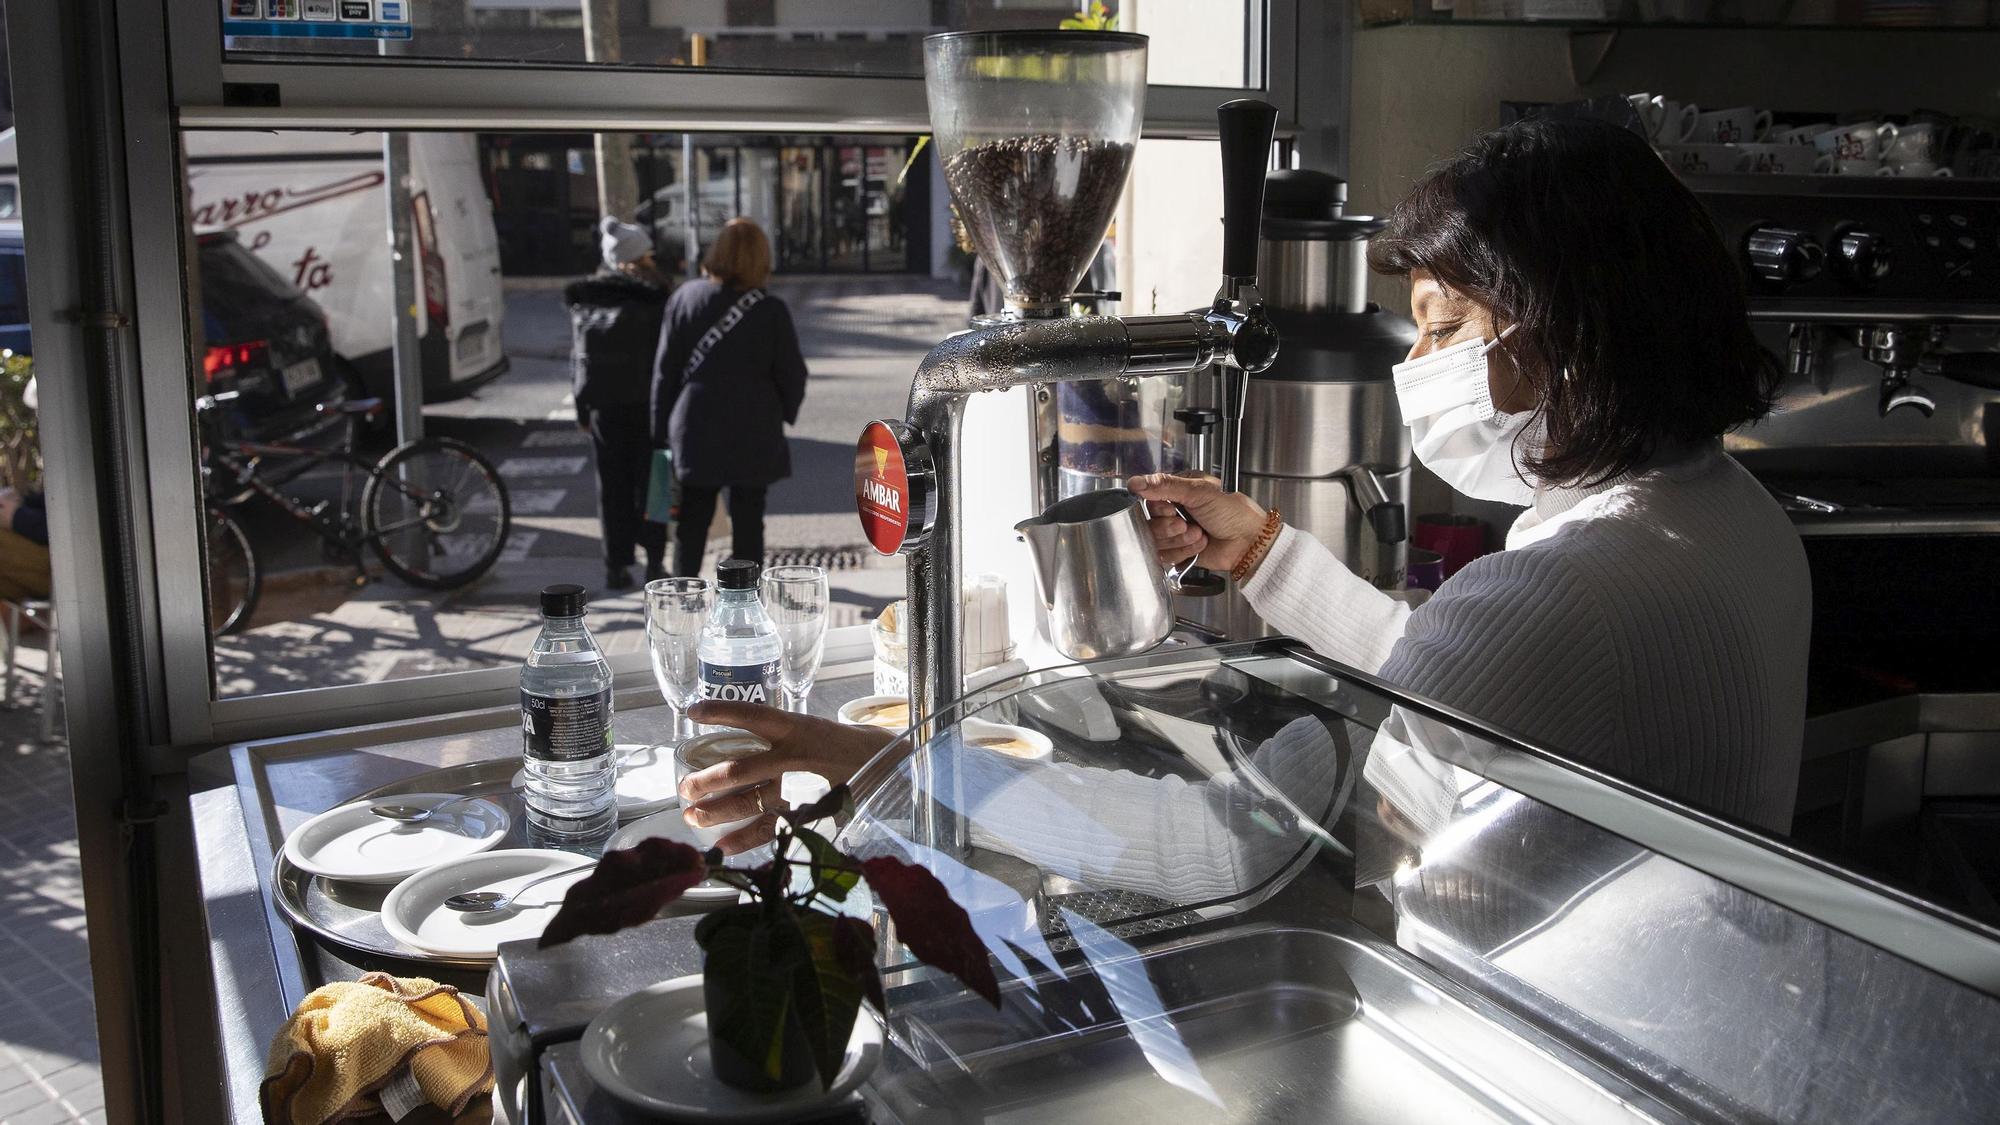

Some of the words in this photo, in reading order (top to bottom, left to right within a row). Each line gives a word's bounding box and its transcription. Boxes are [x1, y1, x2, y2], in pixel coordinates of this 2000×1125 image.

[187, 185, 283, 227] arro
[863, 478, 901, 513] AMBAR
[531, 698, 546, 710] 50cl
